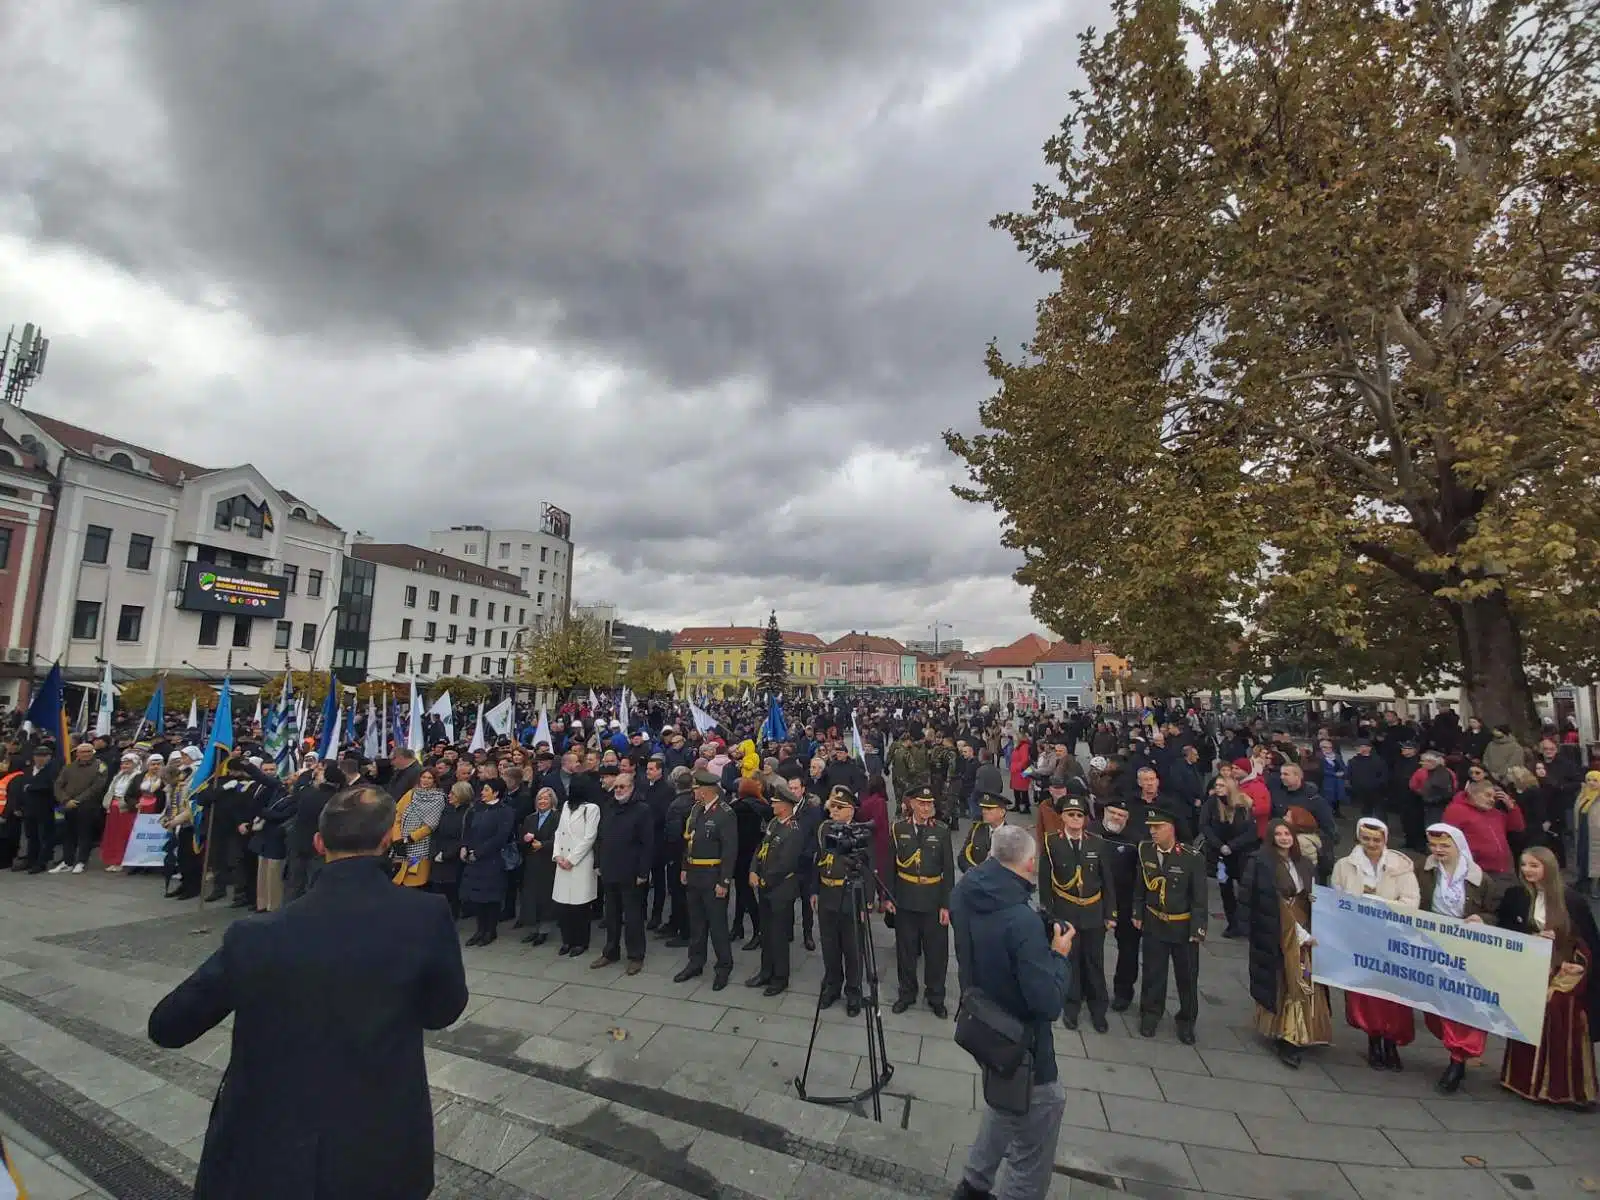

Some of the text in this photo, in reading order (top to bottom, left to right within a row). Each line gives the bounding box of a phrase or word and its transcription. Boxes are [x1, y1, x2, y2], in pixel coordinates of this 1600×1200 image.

[1338, 899, 1524, 953] 25. NOVEMBAR DAN DRŽAVNOSTI BIH
[1353, 953, 1501, 1006] TUZLANSKOG KANTONA
[1387, 939, 1467, 971] INSTITUCIJE
